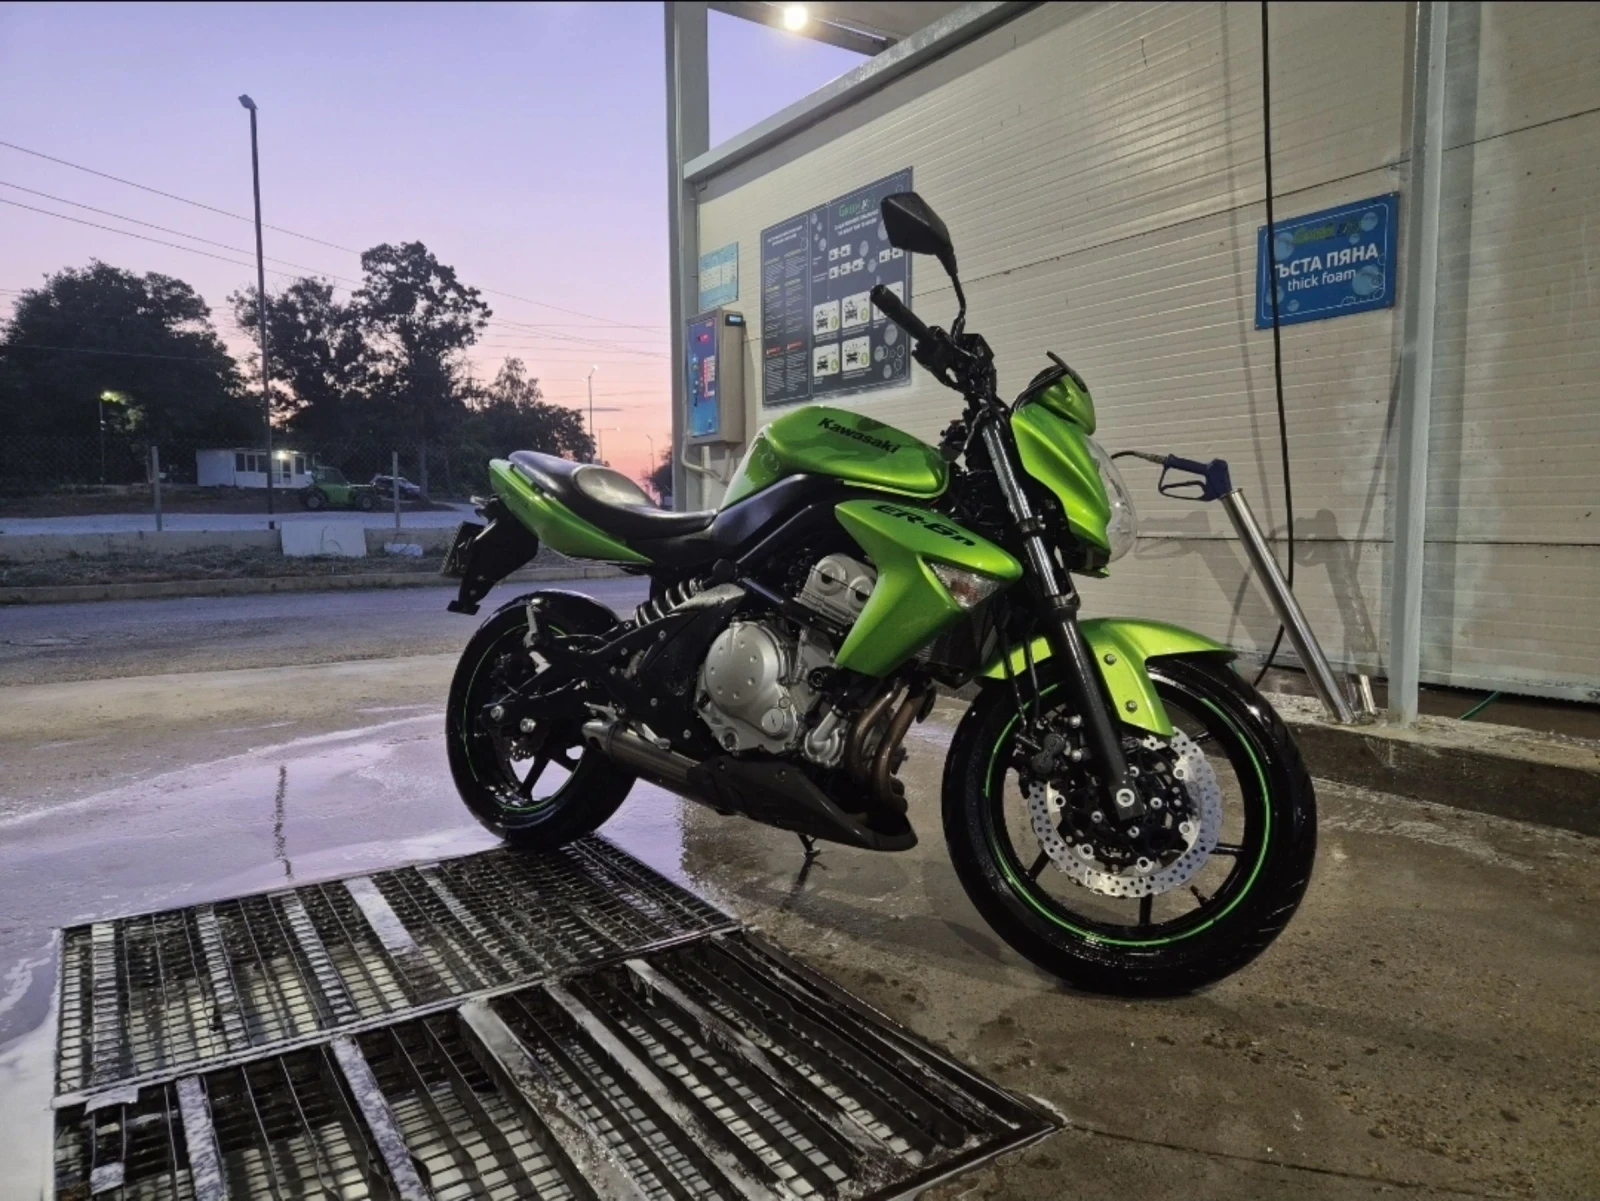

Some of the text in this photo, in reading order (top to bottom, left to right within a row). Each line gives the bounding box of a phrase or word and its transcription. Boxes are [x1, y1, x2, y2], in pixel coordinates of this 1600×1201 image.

[1269, 243, 1379, 281] ЪСТА ПЯНА
[1287, 268, 1356, 292] thick foam
[817, 417, 901, 454] Kawasaki
[872, 504, 977, 547] ER-6n
